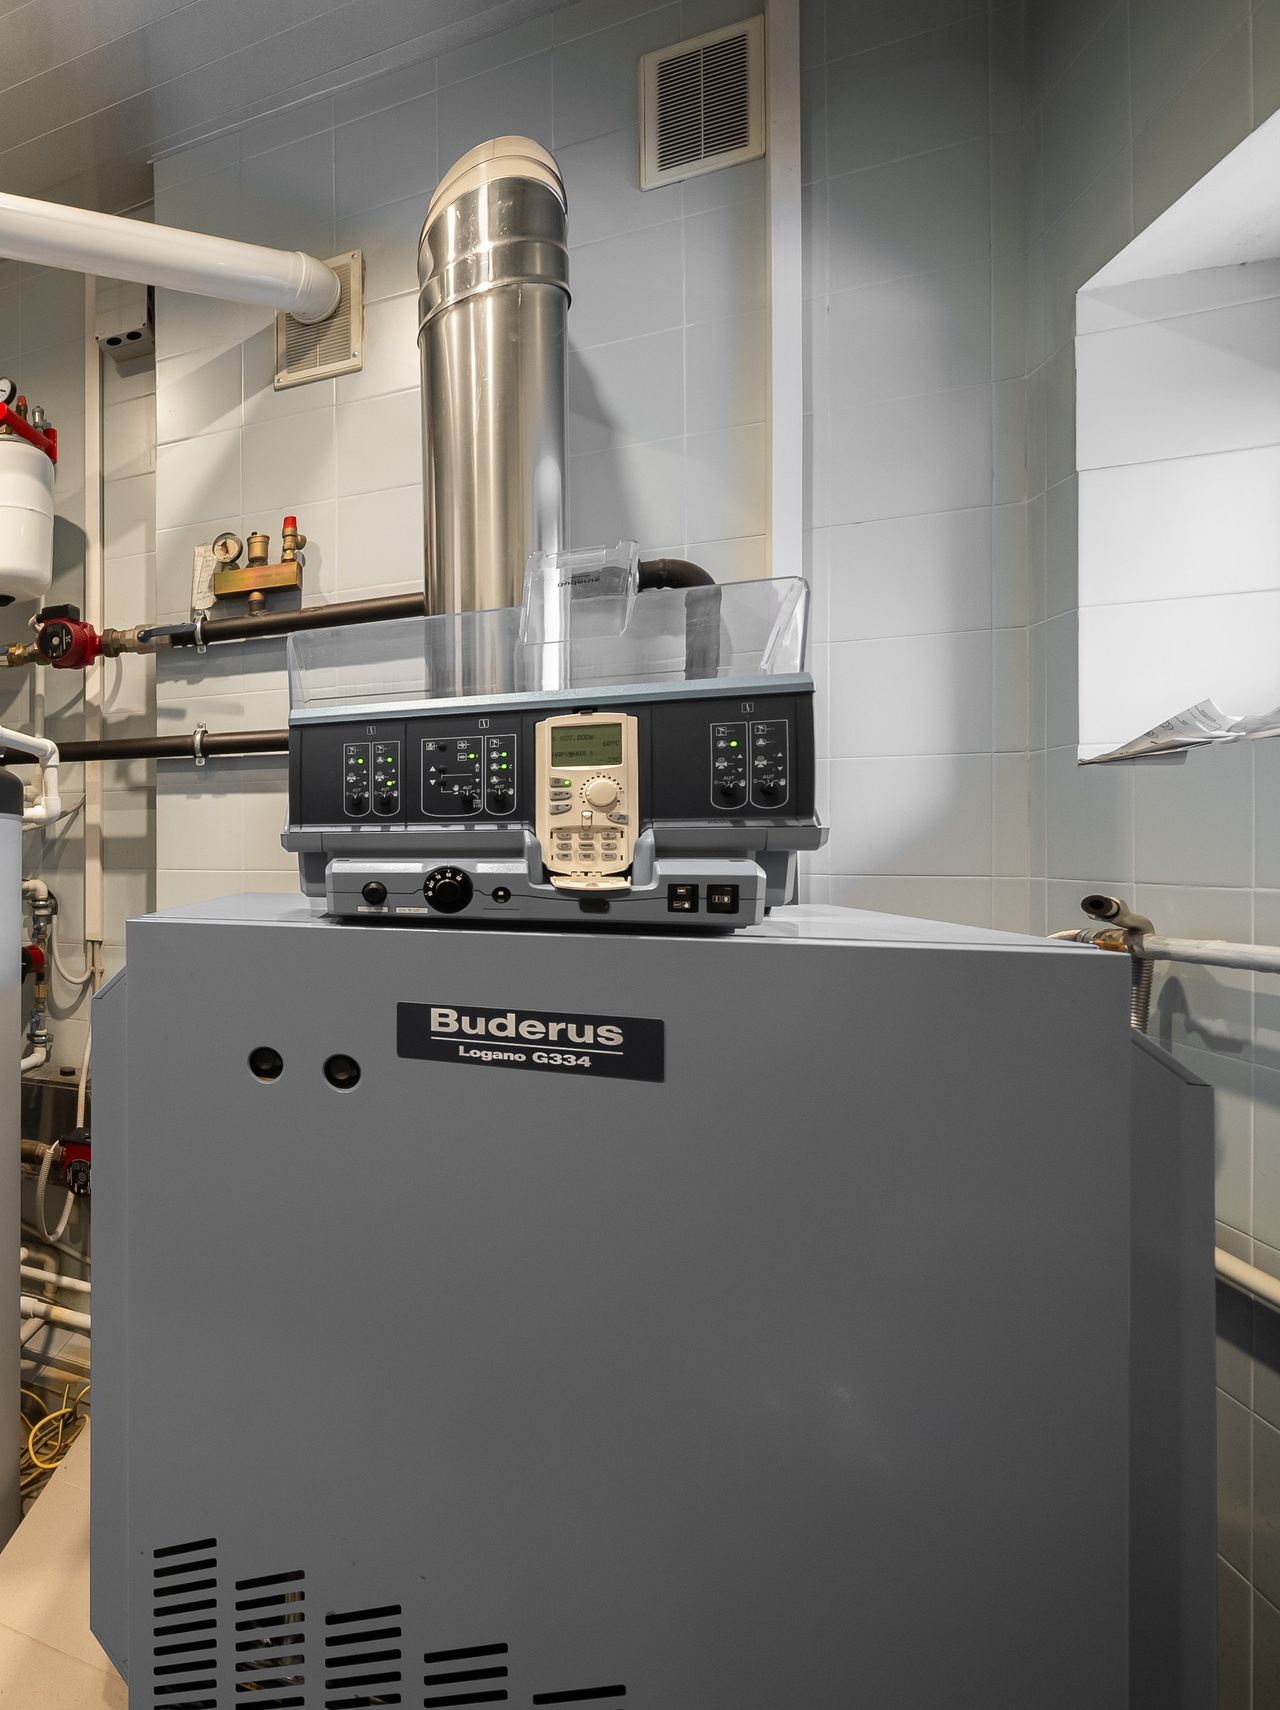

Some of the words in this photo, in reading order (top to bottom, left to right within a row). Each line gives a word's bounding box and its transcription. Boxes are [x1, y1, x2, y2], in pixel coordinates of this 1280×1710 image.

[430, 1007, 624, 1046] Buderus
[459, 1045, 526, 1062] Logano
[532, 1052, 592, 1067] G334
